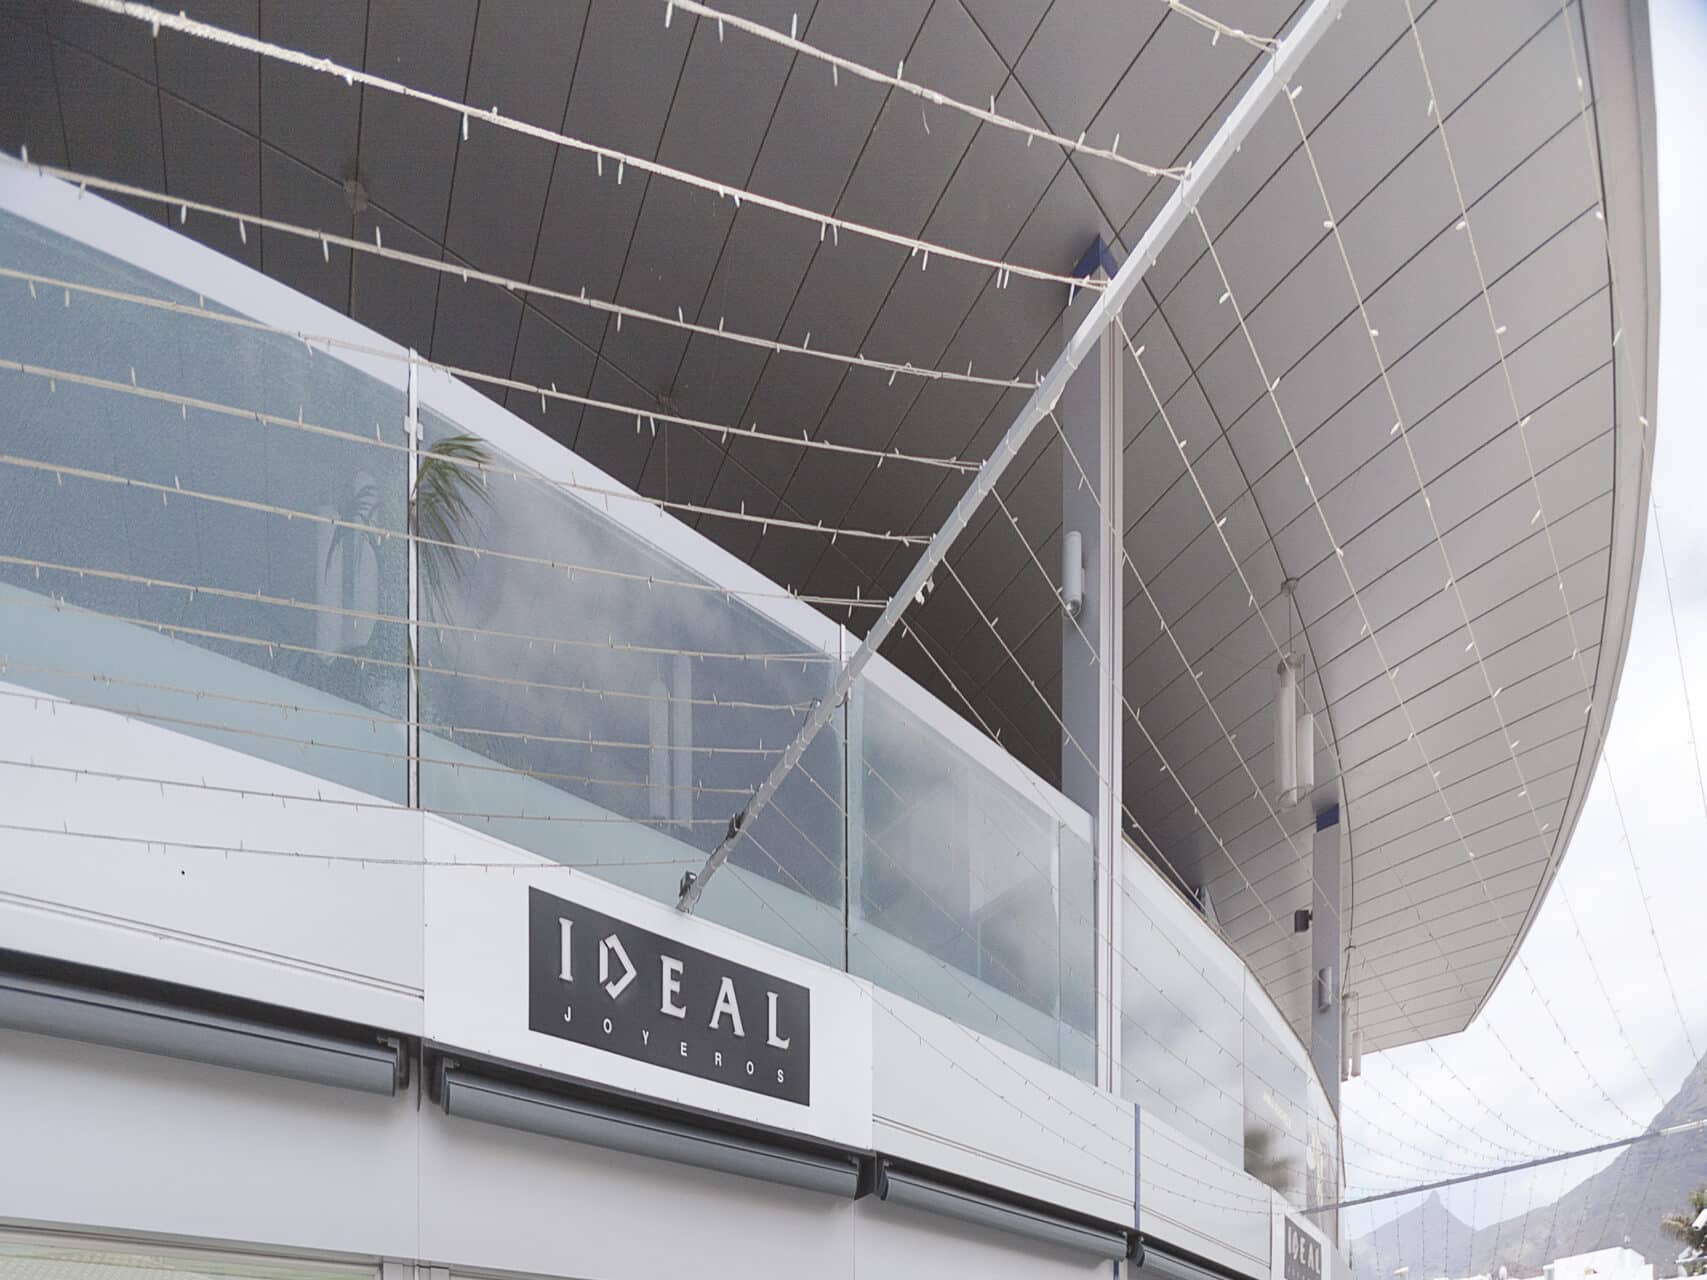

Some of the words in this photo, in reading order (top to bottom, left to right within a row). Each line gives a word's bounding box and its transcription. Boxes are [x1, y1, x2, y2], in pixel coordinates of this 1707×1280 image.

[559, 917, 790, 1050] IDEAL
[564, 1006, 785, 1083] JOYEROS
[1288, 1226, 1320, 1275] IDEAL
